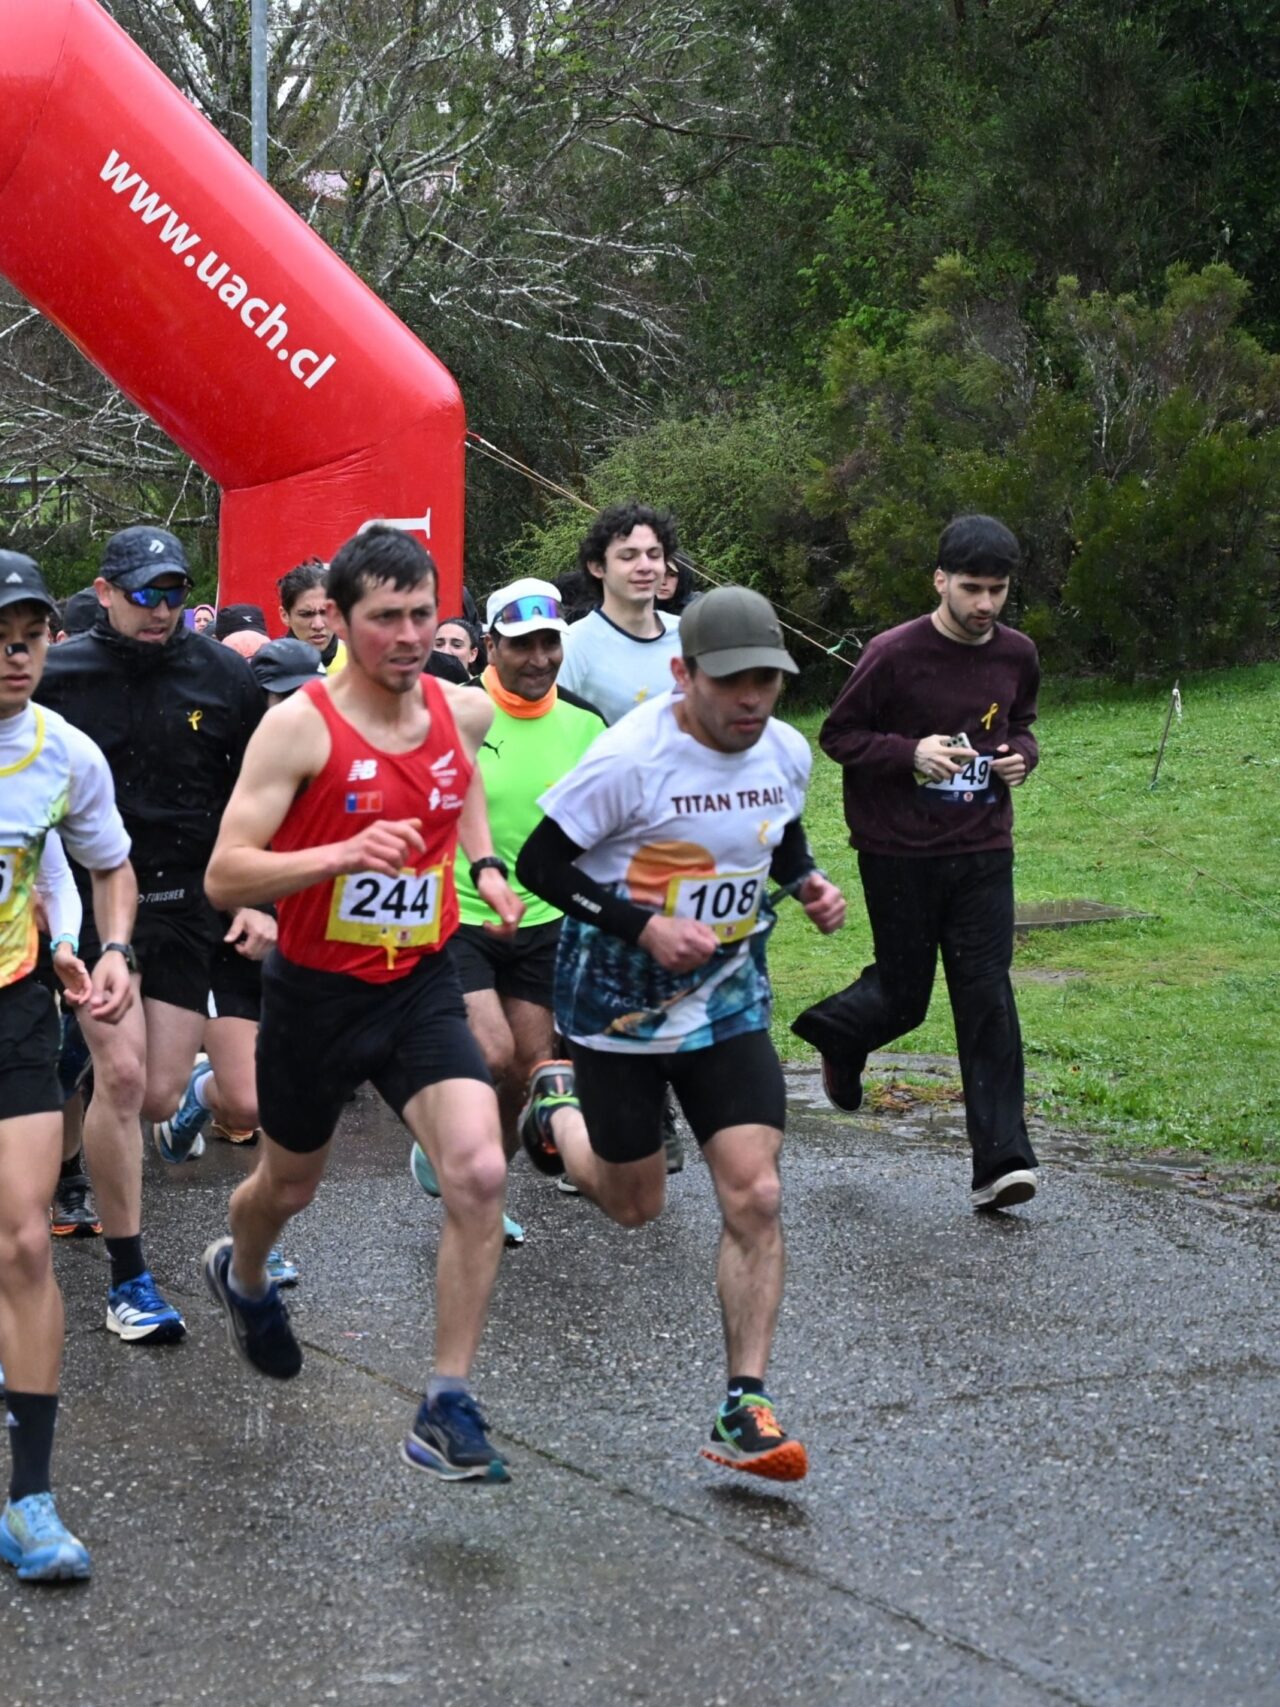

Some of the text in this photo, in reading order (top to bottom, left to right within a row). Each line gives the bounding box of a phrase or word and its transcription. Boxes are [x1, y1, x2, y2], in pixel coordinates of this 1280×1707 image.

[99, 149, 337, 389] www.uach.cl
[671, 794, 732, 815] TITAN
[349, 878, 429, 920] 244
[689, 879, 759, 921] 108
